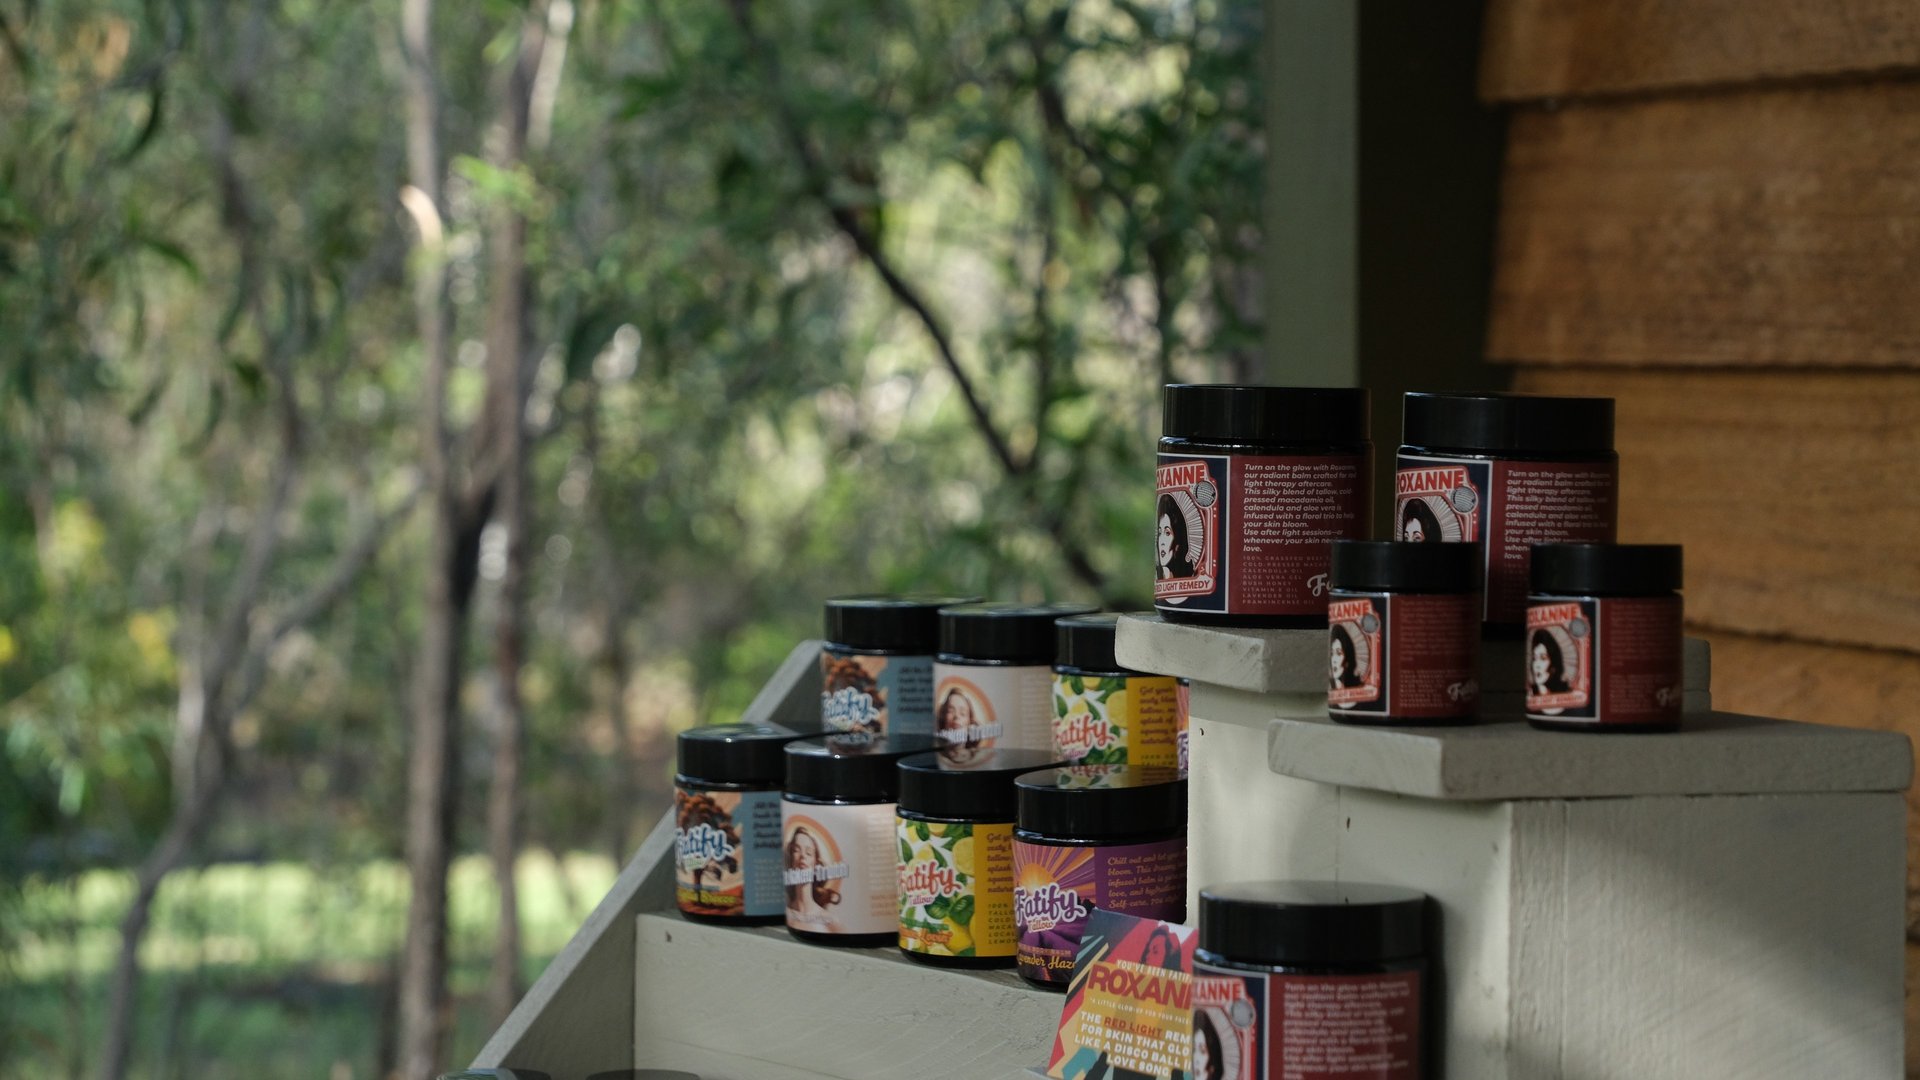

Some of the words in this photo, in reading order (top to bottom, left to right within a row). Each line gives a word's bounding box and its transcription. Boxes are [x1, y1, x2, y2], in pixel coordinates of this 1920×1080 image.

[1292, 465, 1312, 474] glow
[1508, 470, 1527, 478] Turn
[1540, 470, 1554, 478] the
[1157, 465, 1205, 489] XANNE
[1259, 472, 1290, 480] radiant
[1243, 480, 1263, 488] light
[1264, 480, 1297, 489] therapy
[1398, 470, 1465, 493] OXANNE
[1522, 479, 1553, 487] radiant
[1262, 488, 1281, 497] silky
[1282, 488, 1305, 496] blend
[1306, 488, 1315, 496] of
[1315, 488, 1339, 496] tallow,
[1506, 486, 1526, 495] light
[1527, 487, 1559, 496] therapy
[1243, 497, 1276, 505] pressed
[1277, 496, 1324, 504] macadamia
[1507, 494, 1524, 502] This
[1525, 495, 1545, 504] silky
[1545, 495, 1567, 503] blend
[1243, 504, 1284, 512] calendula
[1286, 504, 1301, 512] and
[1303, 504, 1320, 512] aloe
[1505, 504, 1539, 512] pressed
[1243, 512, 1274, 520] infused
[1275, 512, 1293, 520] with
[1302, 512, 1322, 520] floral
[1242, 521, 1262, 530] your
[1505, 519, 1537, 527] infused
[1282, 529, 1301, 538] light
[1504, 529, 1524, 537] your
[1525, 528, 1543, 536] skin
[1242, 537, 1284, 545] whenever
[1285, 538, 1303, 546] your
[1243, 545, 1263, 553] love.
[1504, 552, 1523, 560] love.
[1163, 582, 1178, 593] LIGHT
[1179, 580, 1210, 591] REMEDY
[1107, 856, 1128, 865] Chill
[1107, 868, 1134, 876] bloom.
[1136, 865, 1152, 874] This
[1108, 877, 1137, 888] infused
[1015, 884, 1085, 925] Fatify
[1117, 959, 1144, 973] YOU'VE
[1147, 966, 1165, 977] BEEN
[1194, 981, 1242, 1002] ANNE
[1097, 999, 1116, 1009] LITTLE
[1081, 1010, 1102, 1024] THE
[1103, 1016, 1126, 1029] RED
[1129, 1020, 1163, 1037] LIGHT
[1081, 1023, 1103, 1036] FOR
[1105, 1028, 1133, 1044] SKIN
[1136, 1036, 1166, 1051] THAT
[1074, 1034, 1100, 1048] LIKE
[1103, 1040, 1111, 1051] A
[1114, 1042, 1149, 1060] DISCO
[1151, 1051, 1181, 1068] BALL
[1106, 1053, 1136, 1069] LOVE
[1139, 1060, 1170, 1076] SONG
